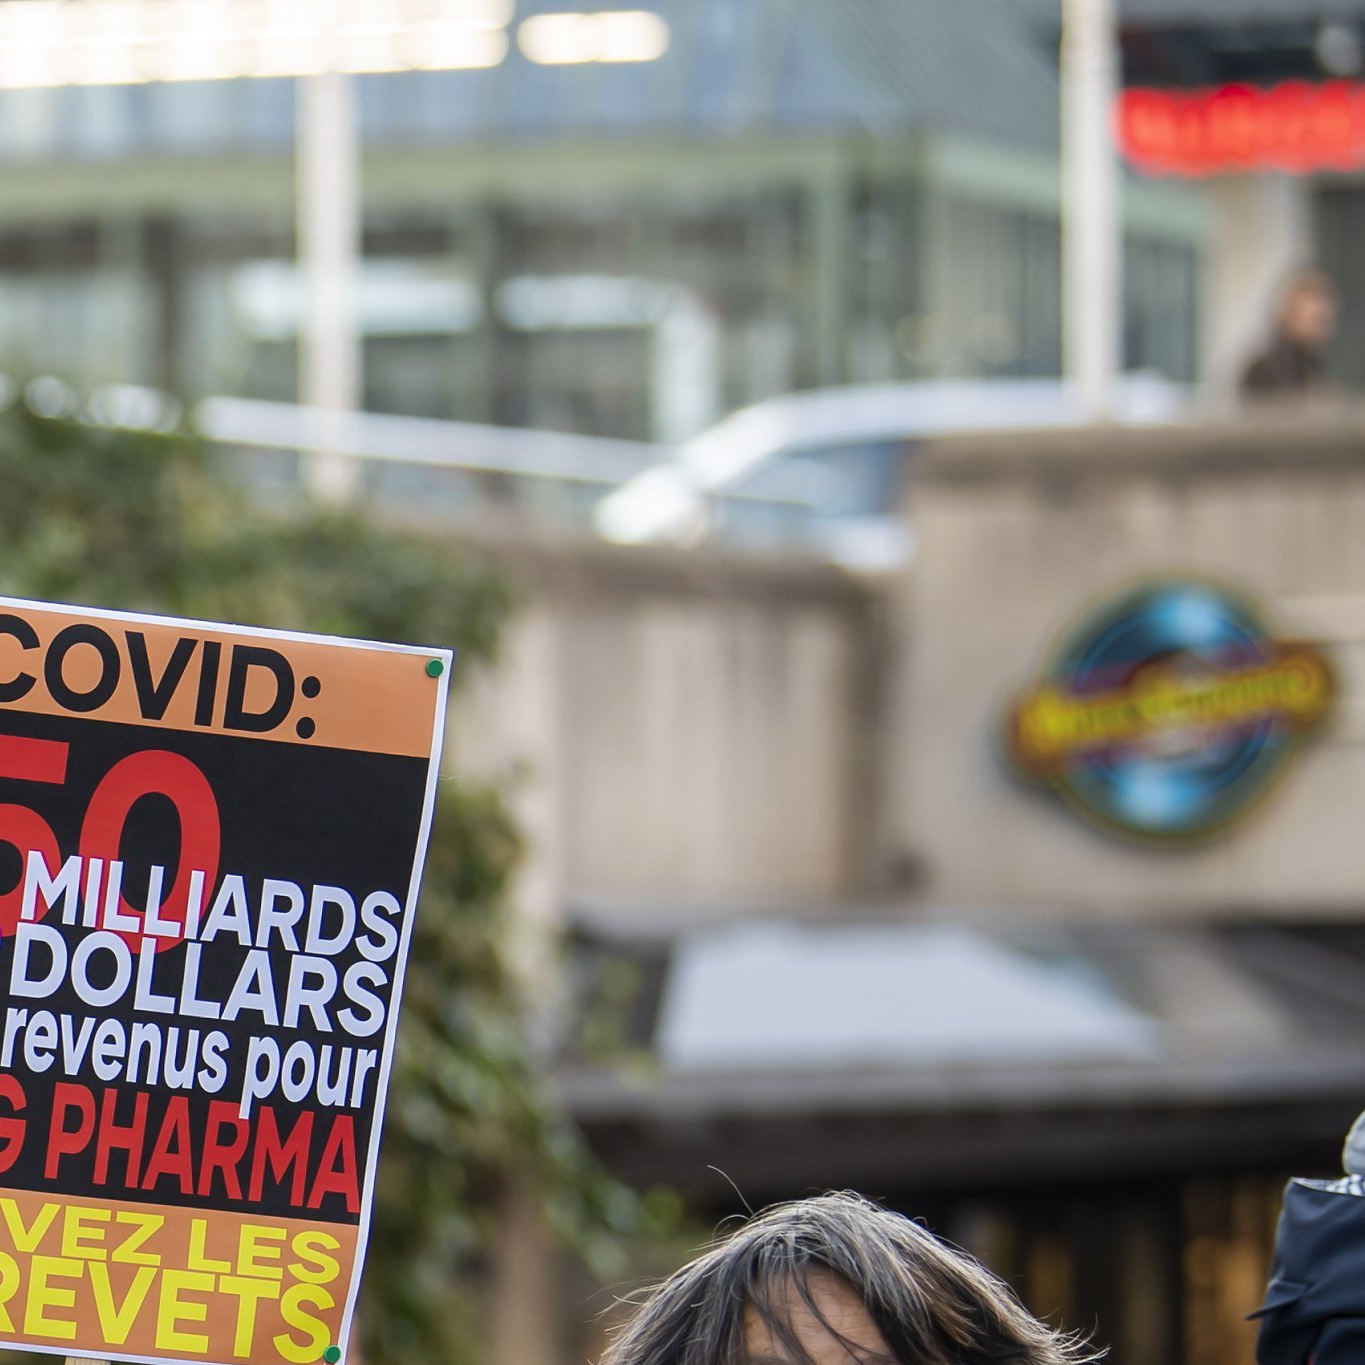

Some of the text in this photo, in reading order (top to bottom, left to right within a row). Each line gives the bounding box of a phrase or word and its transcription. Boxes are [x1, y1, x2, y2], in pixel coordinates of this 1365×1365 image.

[20, 850, 401, 963] MILLIARDS
[9, 922, 389, 1037] DOLLARS
[0, 1007, 229, 1094] revenus
[239, 1034, 378, 1120] pour
[44, 1081, 362, 1213] PHARMA
[188, 1218, 341, 1285] LES
